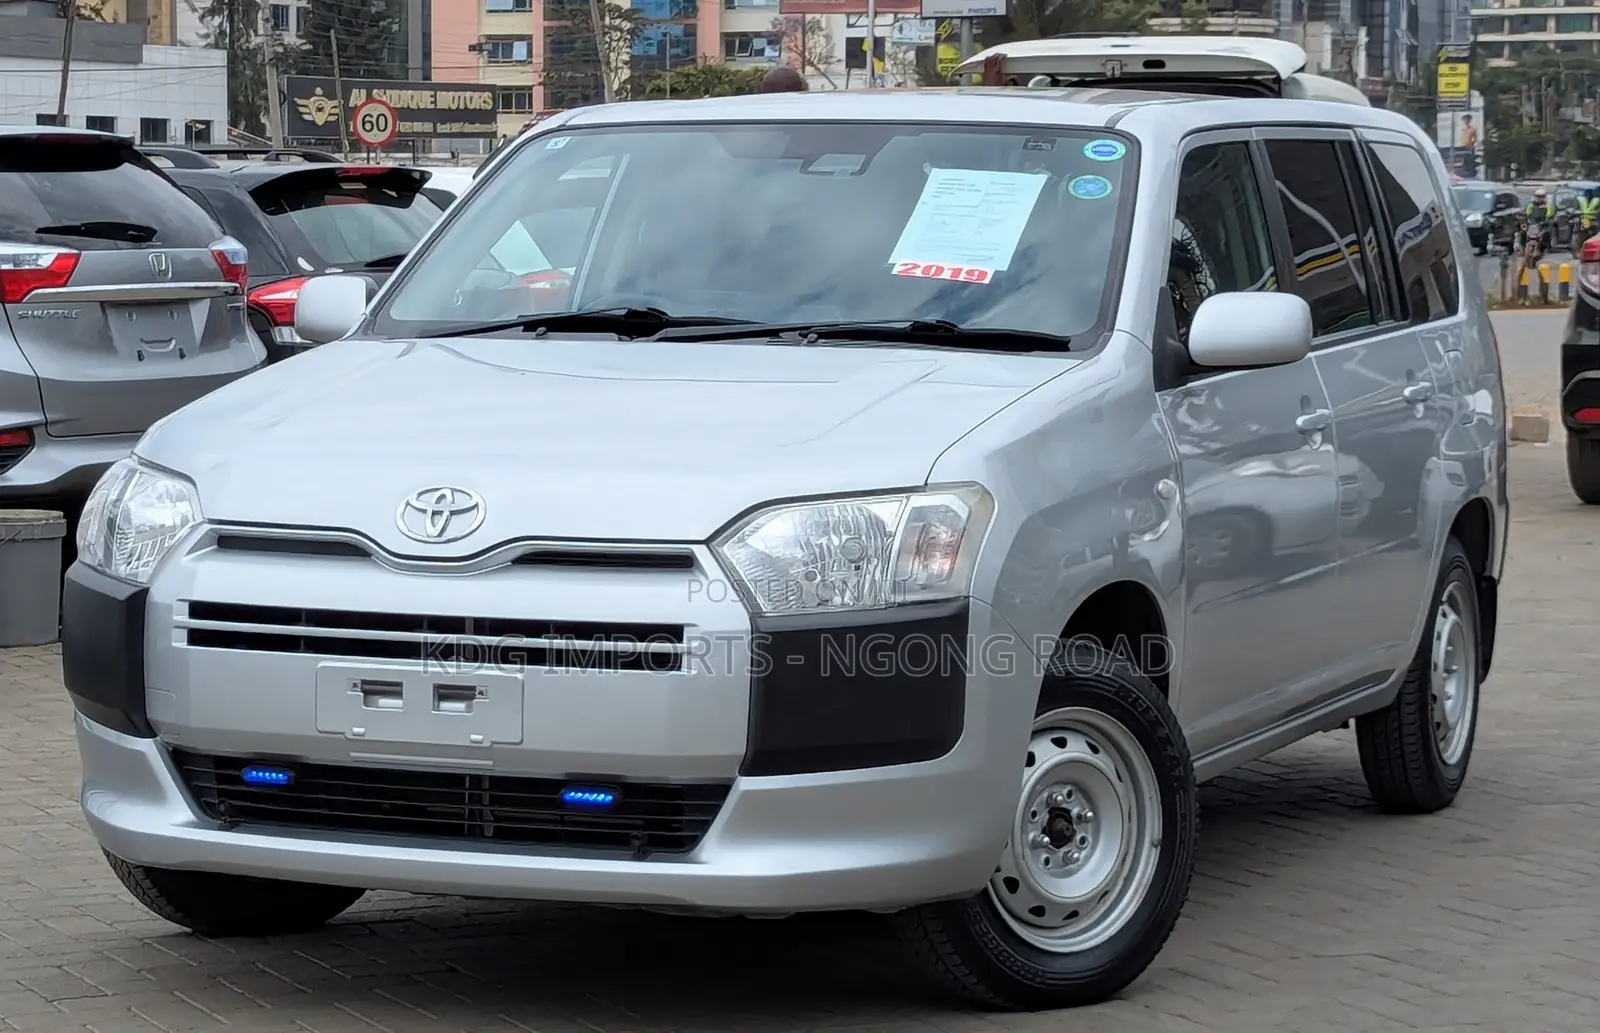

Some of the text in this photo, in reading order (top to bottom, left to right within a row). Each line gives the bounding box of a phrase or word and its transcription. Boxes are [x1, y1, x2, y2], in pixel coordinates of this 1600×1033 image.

[436, 90, 493, 110] MOTORS
[361, 113, 388, 133] 60
[896, 262, 989, 282] 2019
[17, 309, 81, 320] SHUTTLE
